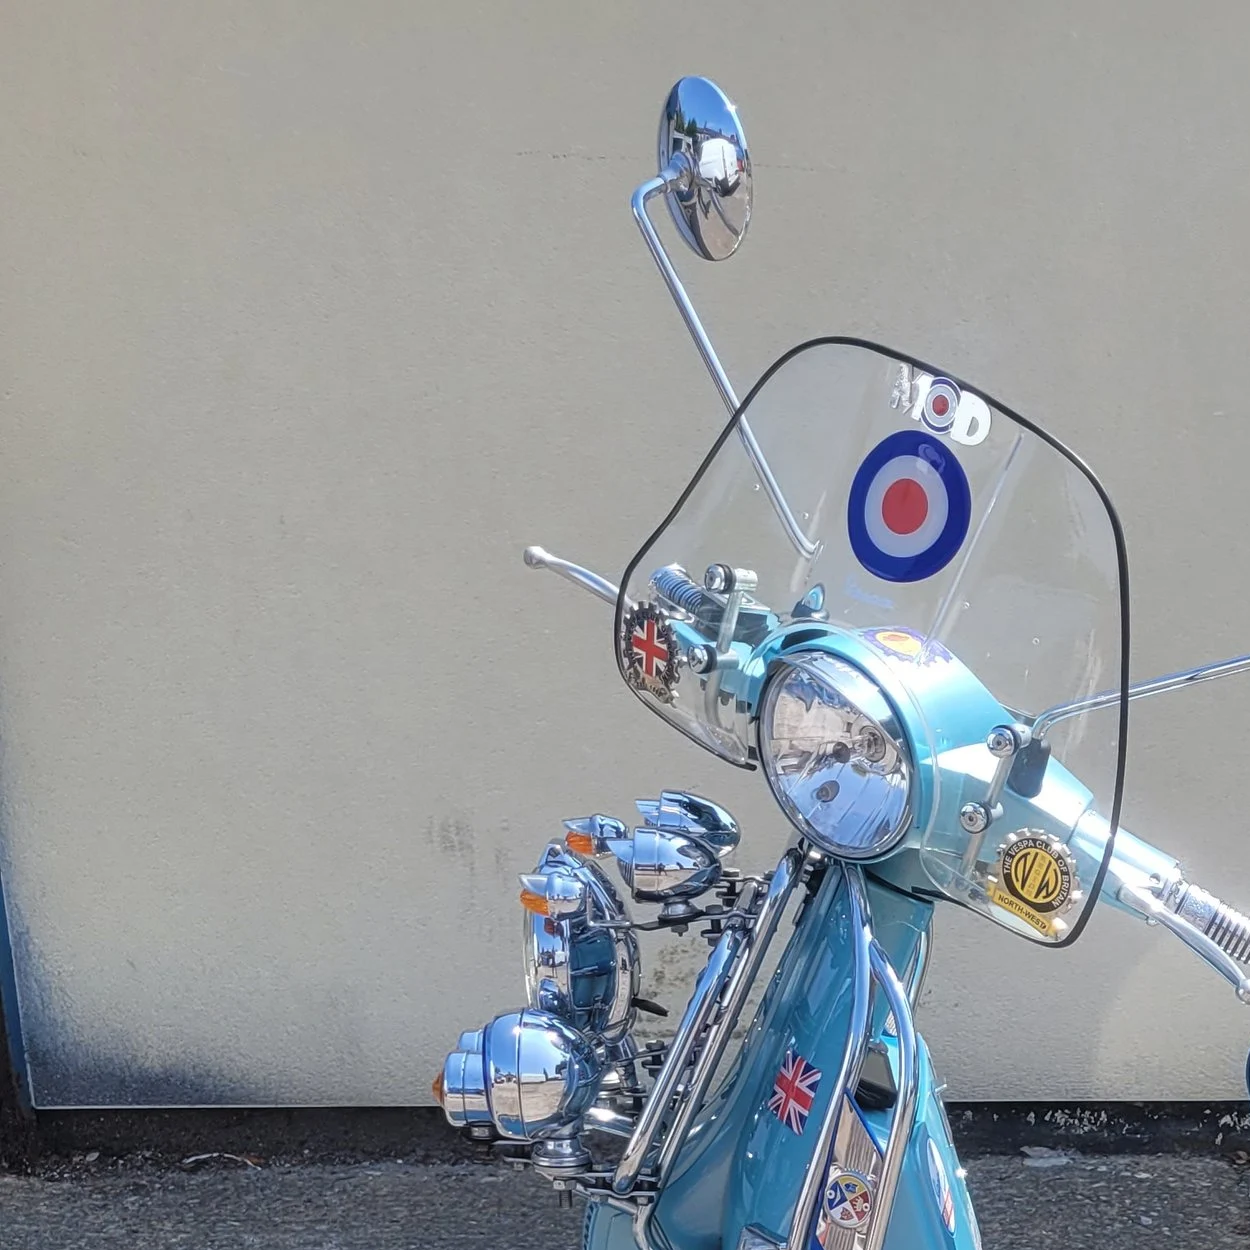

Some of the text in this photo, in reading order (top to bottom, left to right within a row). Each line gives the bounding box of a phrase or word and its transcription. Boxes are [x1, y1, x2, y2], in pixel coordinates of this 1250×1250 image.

[1003, 840, 1070, 908] THE VESPA CLUB OF BRITAIN
